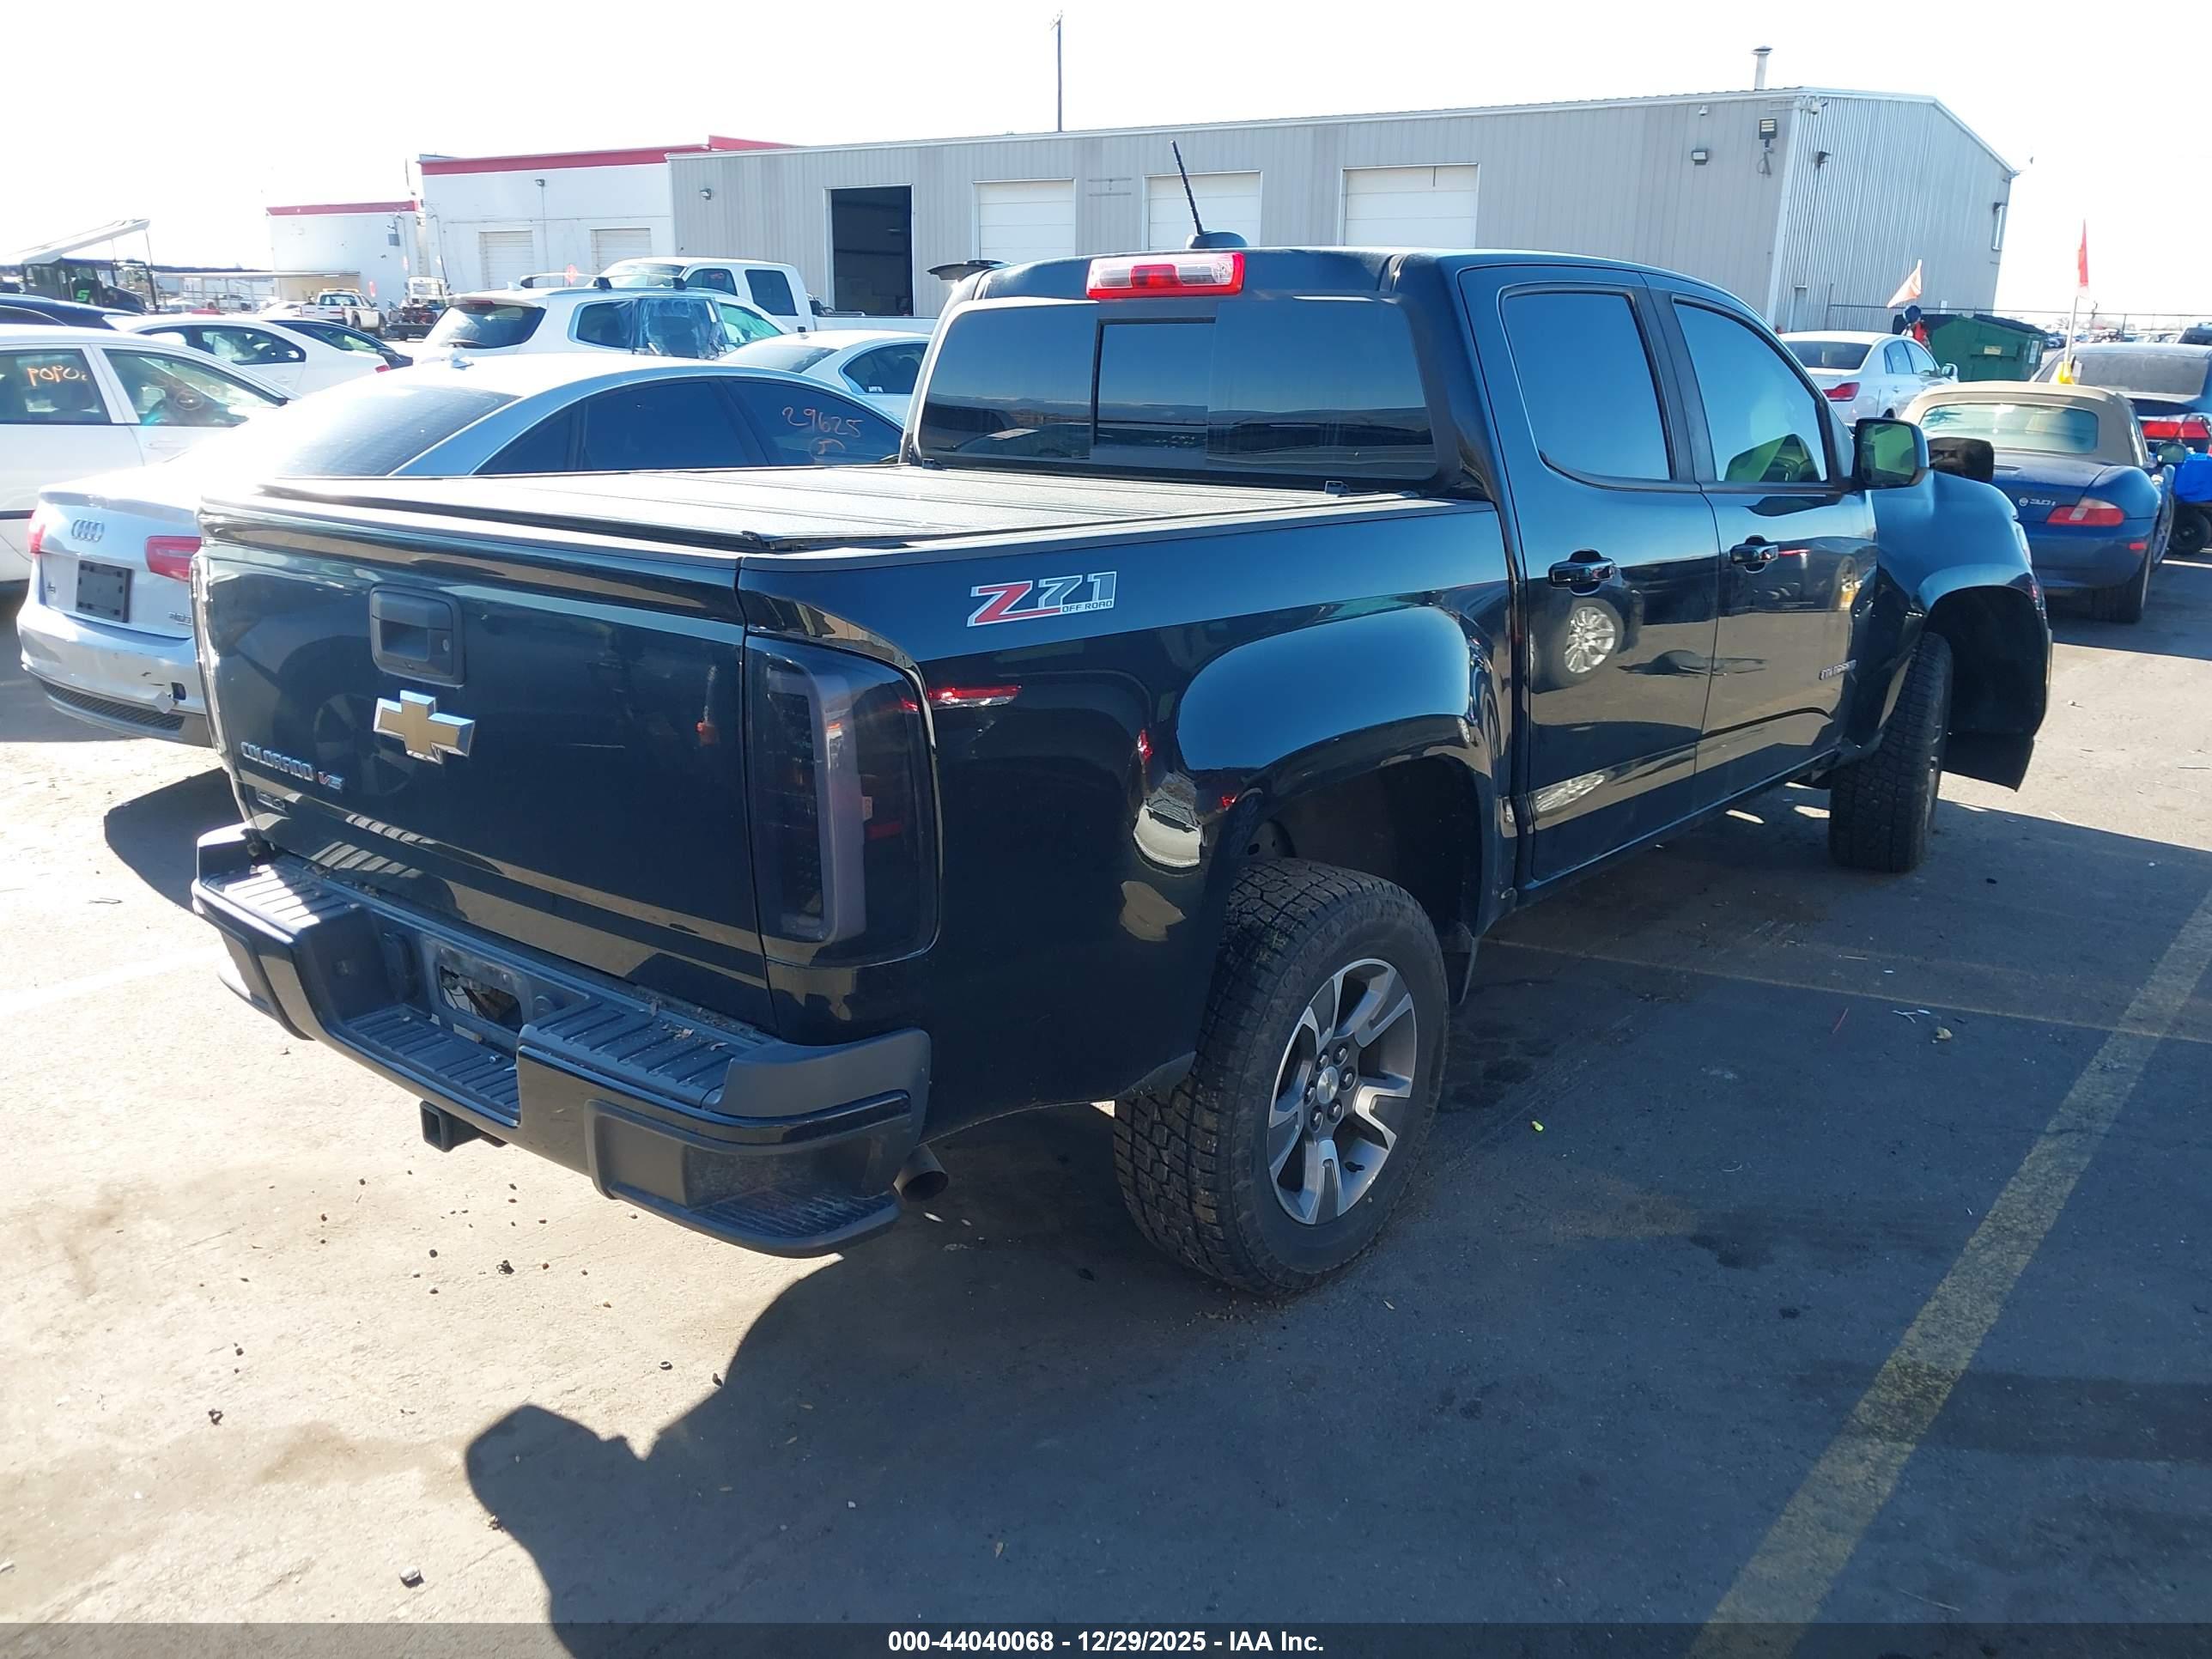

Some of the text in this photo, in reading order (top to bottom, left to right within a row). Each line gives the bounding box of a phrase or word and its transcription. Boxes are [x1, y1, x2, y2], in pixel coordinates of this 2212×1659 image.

[781, 406, 864, 438] 29625
[967, 571, 1117, 627] Z71
[1062, 600, 1113, 613] OFF ROAD
